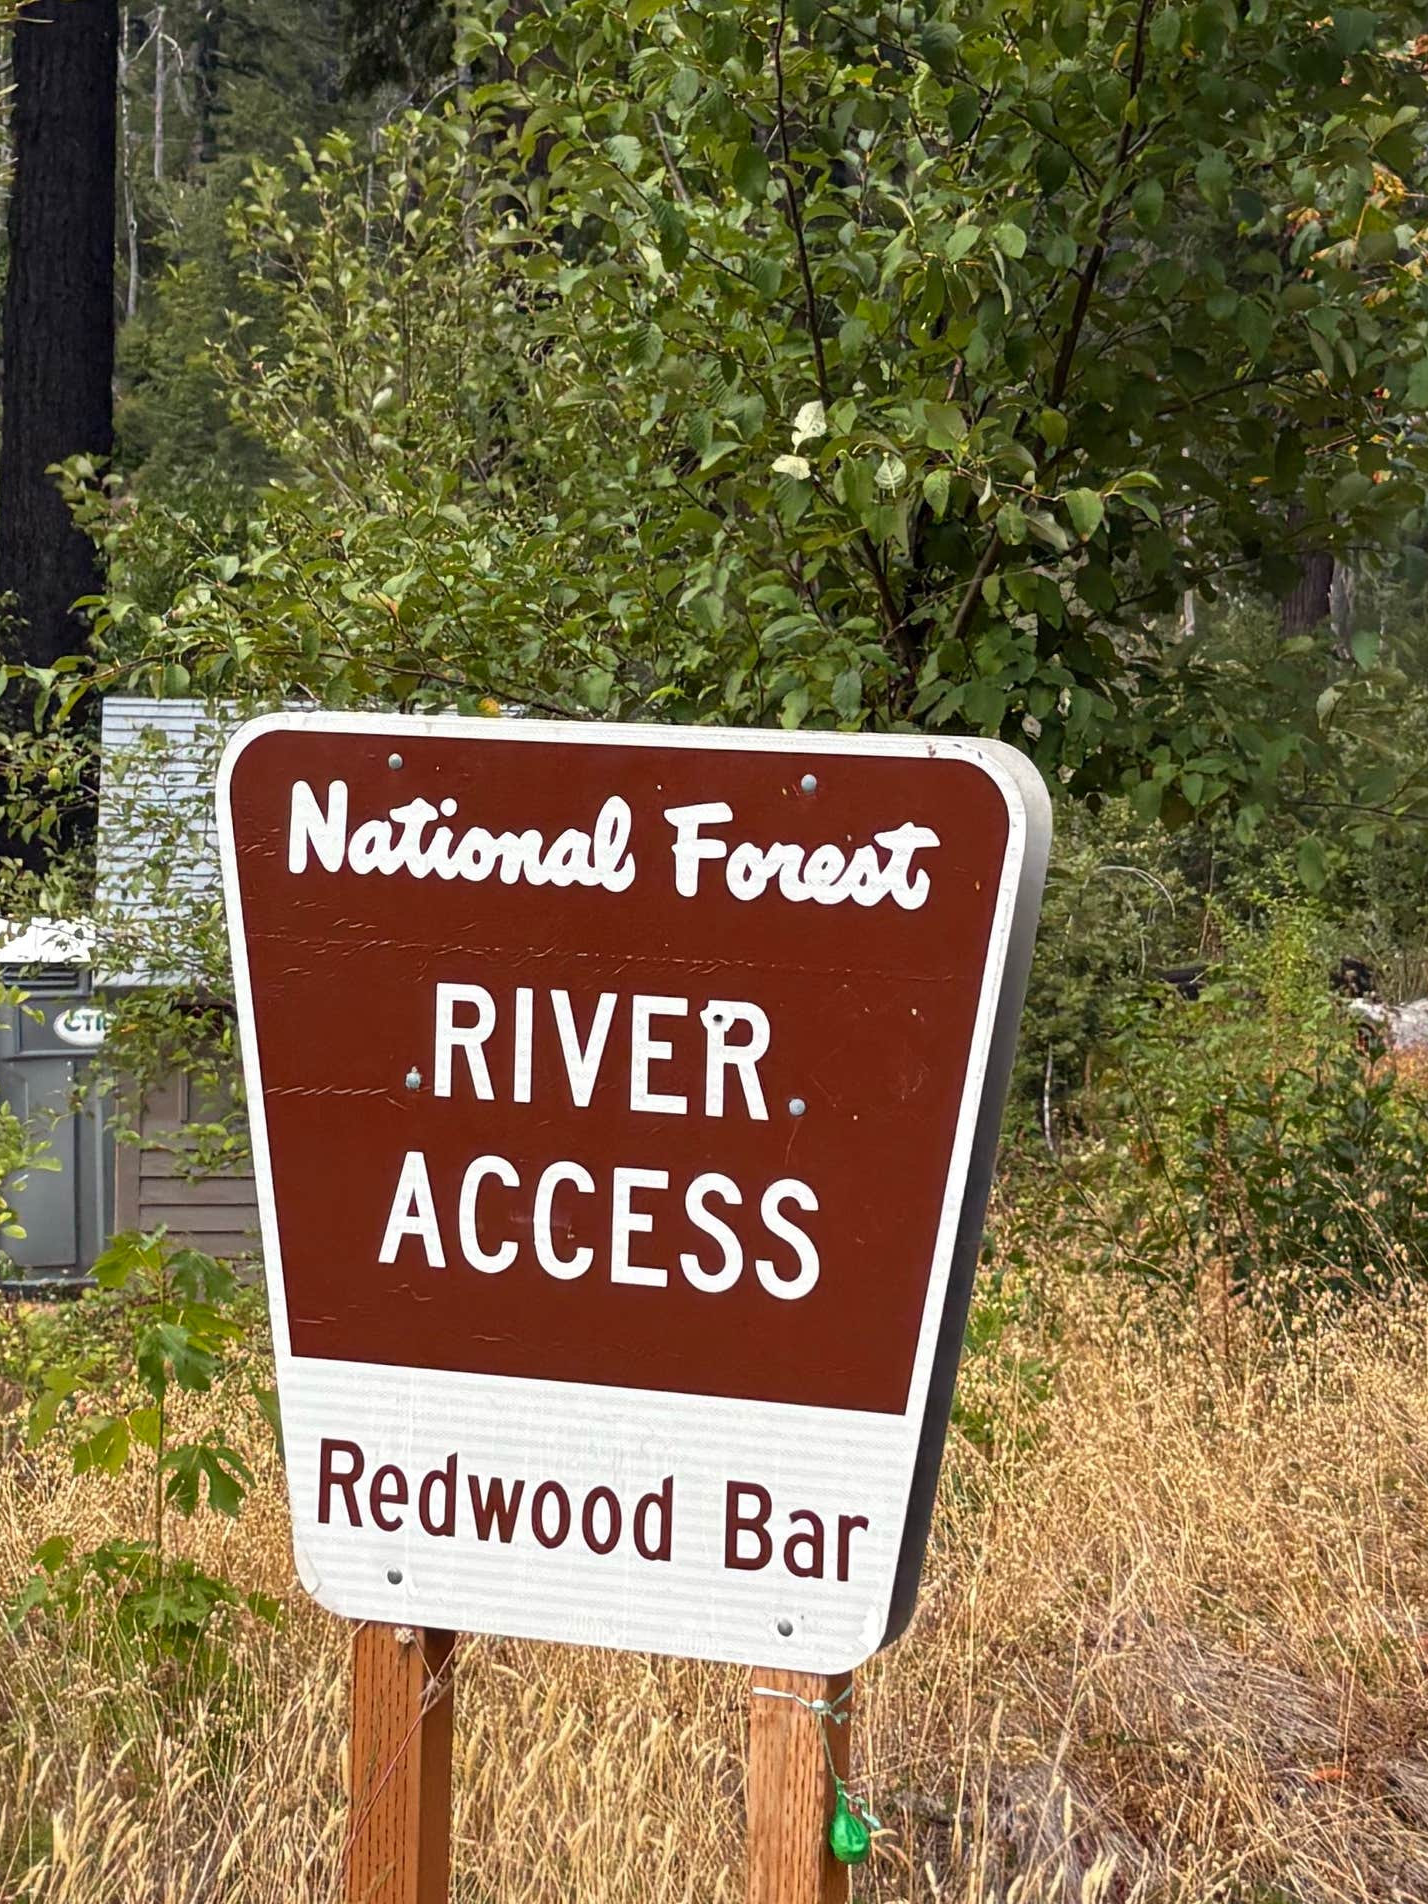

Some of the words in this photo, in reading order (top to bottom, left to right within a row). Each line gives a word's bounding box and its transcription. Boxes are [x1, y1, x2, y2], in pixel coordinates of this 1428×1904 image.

[288, 779, 636, 893] National
[663, 801, 941, 910] Forest
[434, 982, 771, 1121] RIVER
[378, 1151, 820, 1300] ACCESS
[317, 1438, 674, 1562] Redwood
[724, 1480, 869, 1582] Bar
